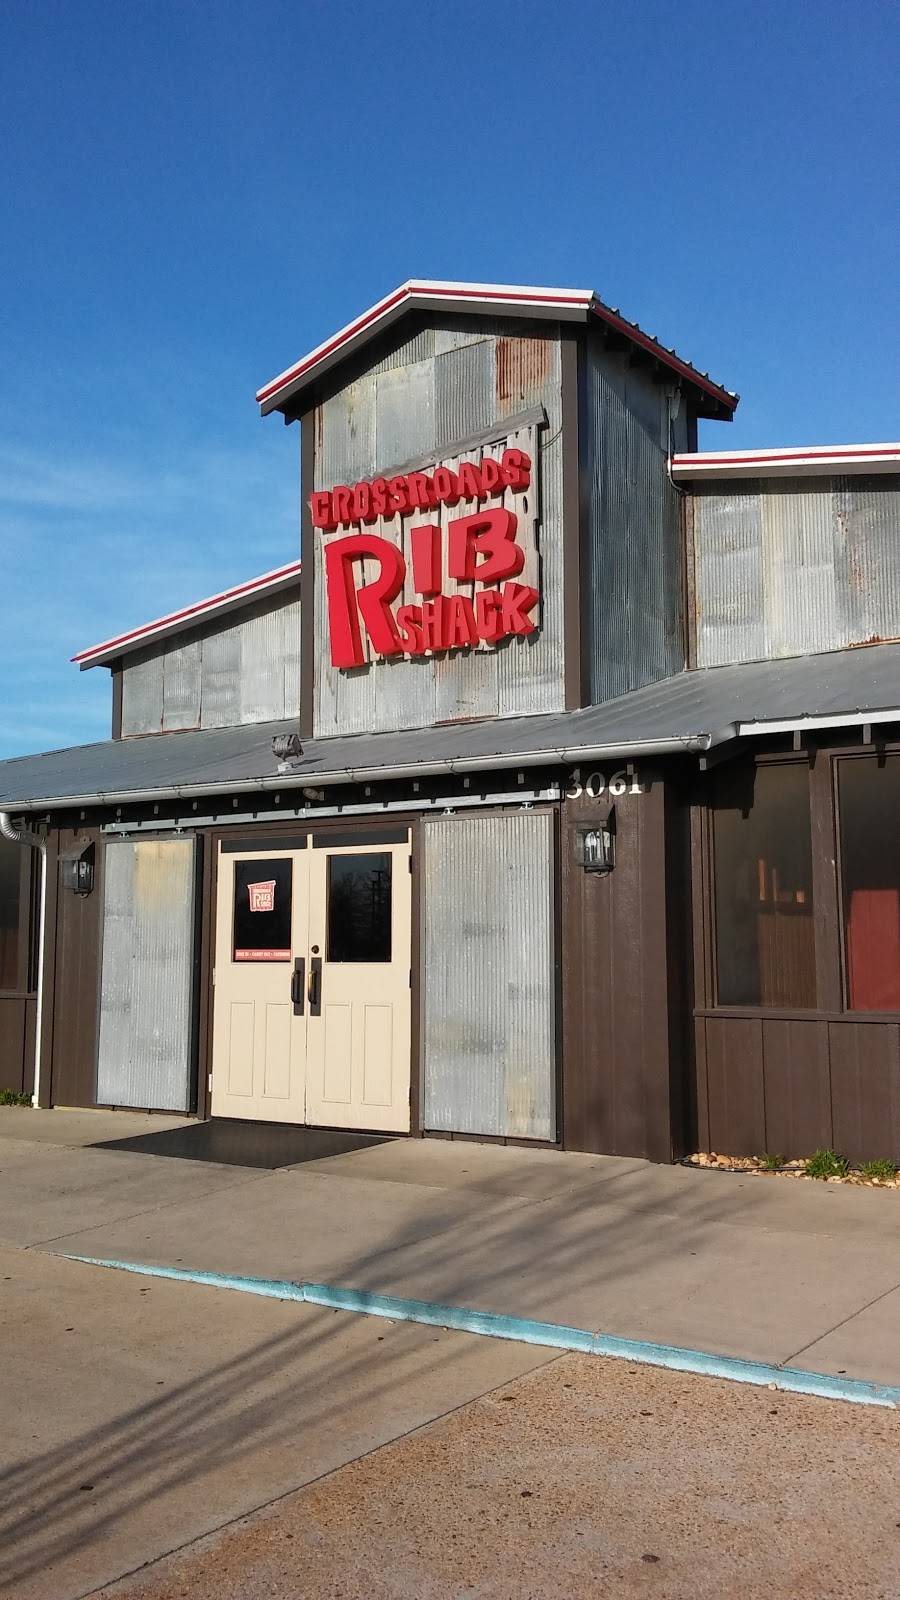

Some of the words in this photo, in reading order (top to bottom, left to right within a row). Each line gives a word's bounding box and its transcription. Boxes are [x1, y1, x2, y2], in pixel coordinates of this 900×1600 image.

[310, 448, 531, 529] CROSSROADS
[324, 506, 525, 668] RIB
[396, 581, 540, 655] SHACK
[566, 768, 643, 799] 3061
